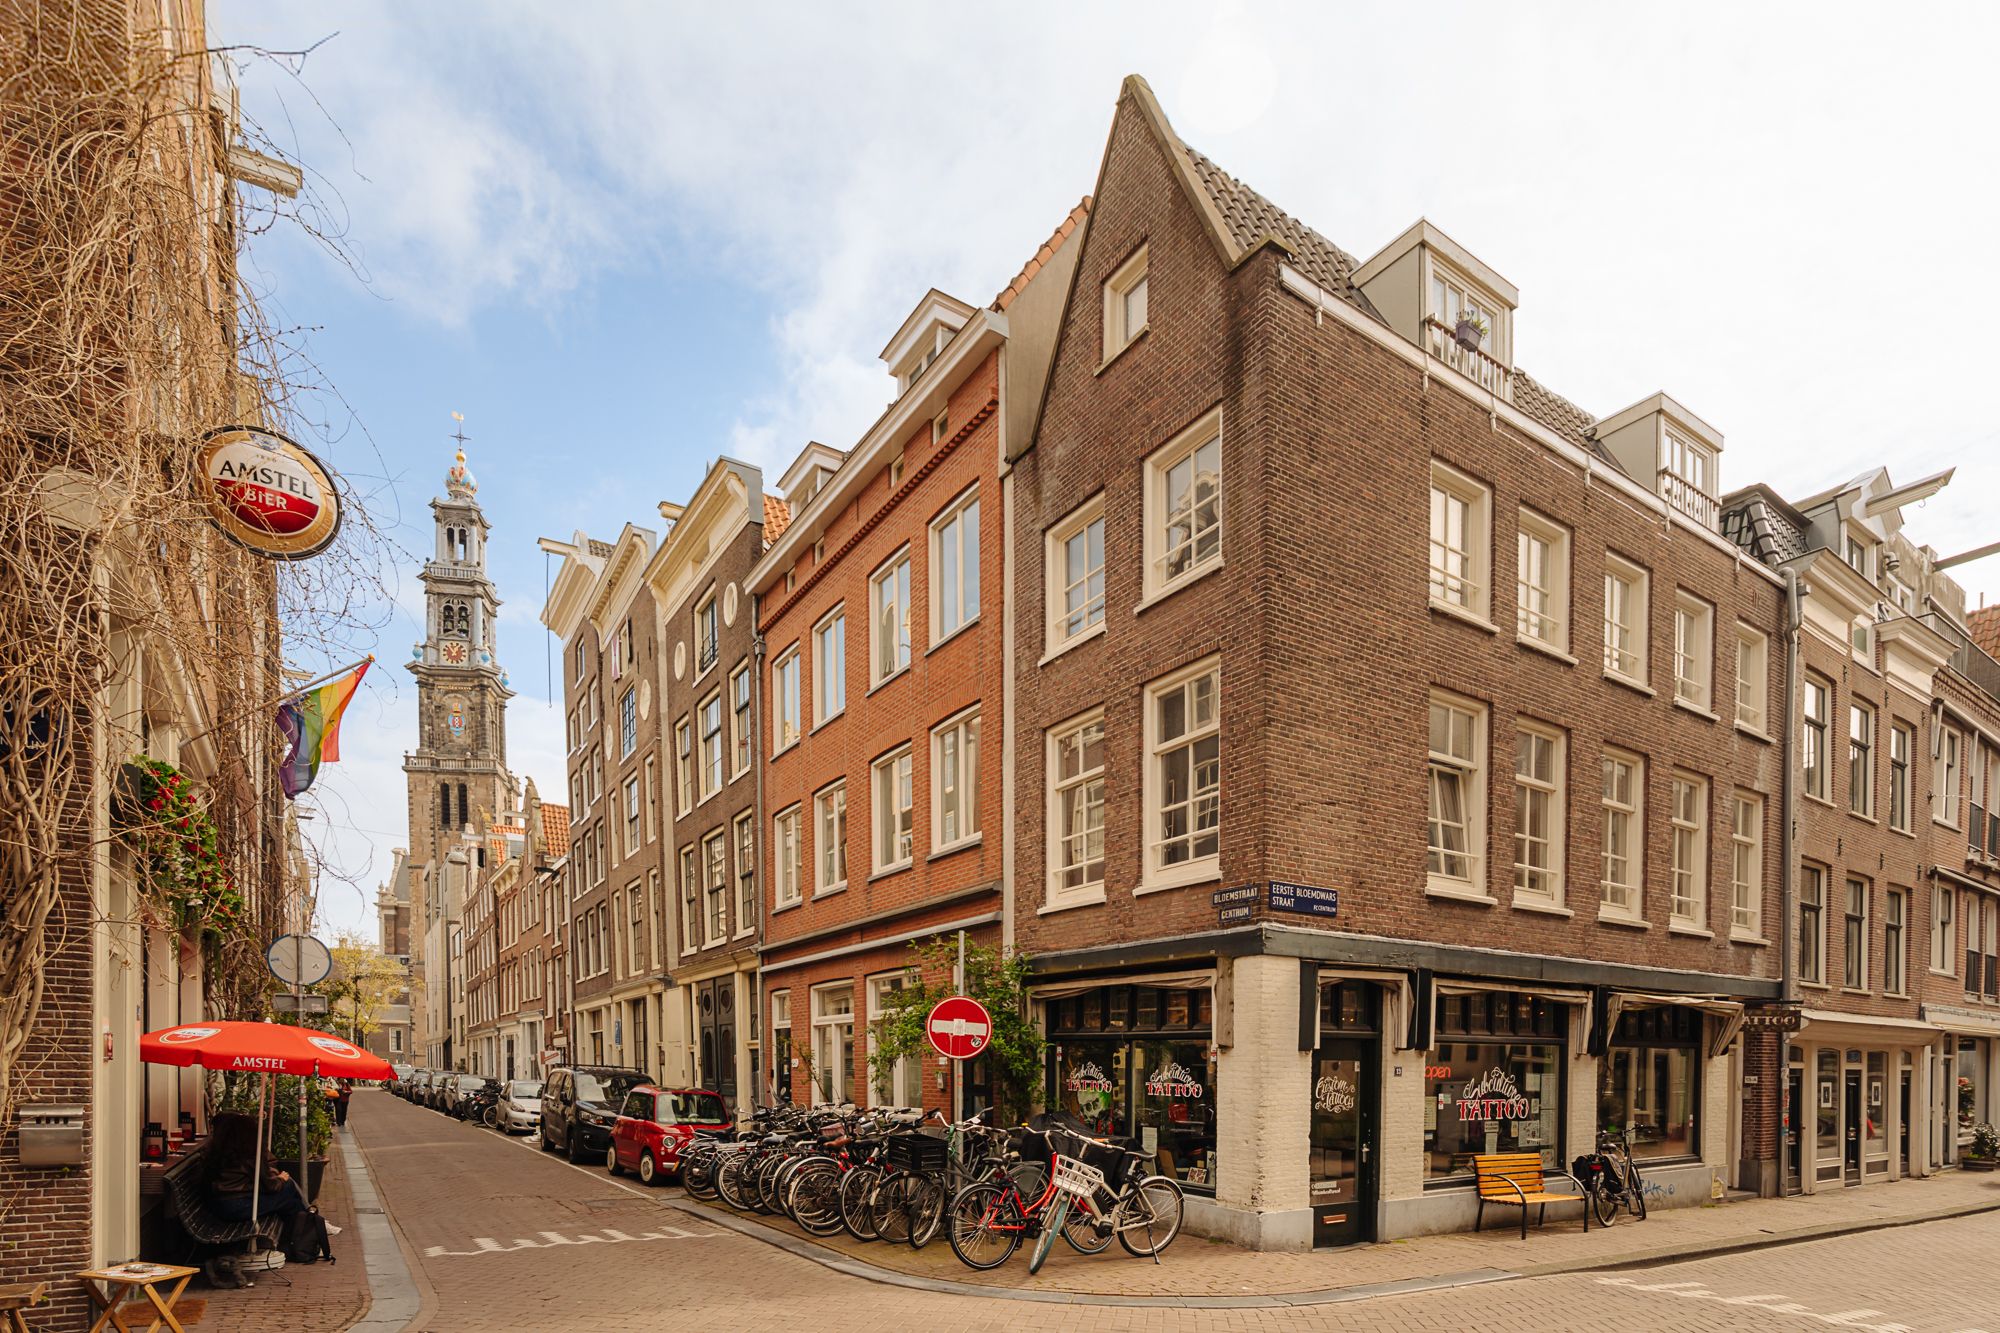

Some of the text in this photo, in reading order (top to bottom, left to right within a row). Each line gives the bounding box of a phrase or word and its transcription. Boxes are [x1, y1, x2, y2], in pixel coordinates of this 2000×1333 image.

[219, 460, 313, 499] AMSTEL
[245, 489, 287, 510] BIER
[1213, 887, 1258, 904] BLOEMSTRAAT
[1272, 884, 1337, 902] EERSTE BLOEMDWARS
[1272, 896, 1295, 908] STRAAT
[1221, 907, 1249, 919] CENTRUM
[1742, 1016, 1795, 1025] ATTOO
[232, 1056, 286, 1069] AMSTEL
[1424, 1066, 1451, 1080] open
[1066, 1079, 1112, 1093] TATTOO
[1145, 1082, 1203, 1098] TATTOO
[1456, 1099, 1530, 1120] TATTOO
